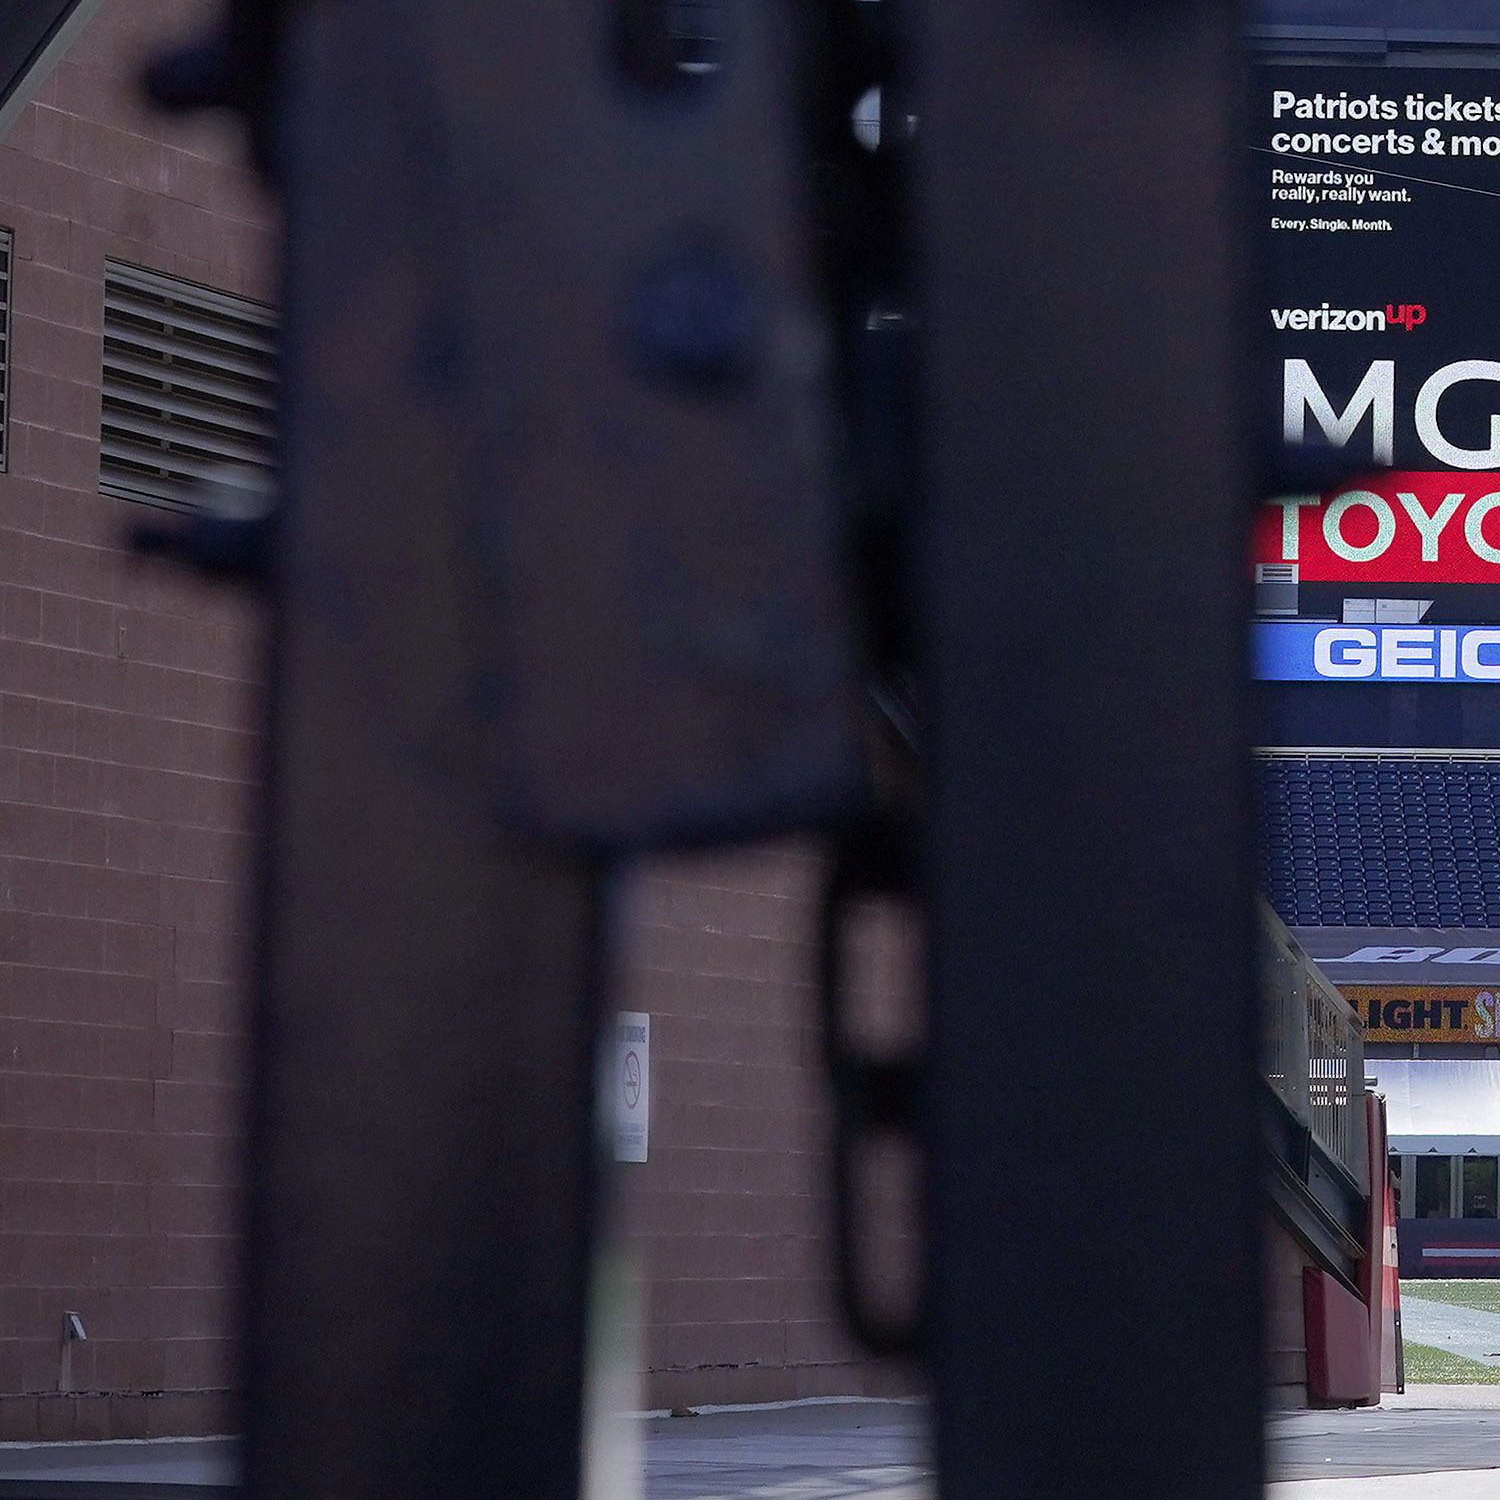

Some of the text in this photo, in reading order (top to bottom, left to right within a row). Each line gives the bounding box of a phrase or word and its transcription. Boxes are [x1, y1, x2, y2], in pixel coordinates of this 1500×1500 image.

[1272, 91, 1398, 120] Patriots
[1271, 129, 1415, 155] concerts
[1421, 128, 1446, 156] &
[1272, 169, 1374, 188] Rewards you
[1272, 186, 1412, 205] really, really want.
[1271, 218, 1309, 231] Every.
[1352, 219, 1392, 231] Month.
